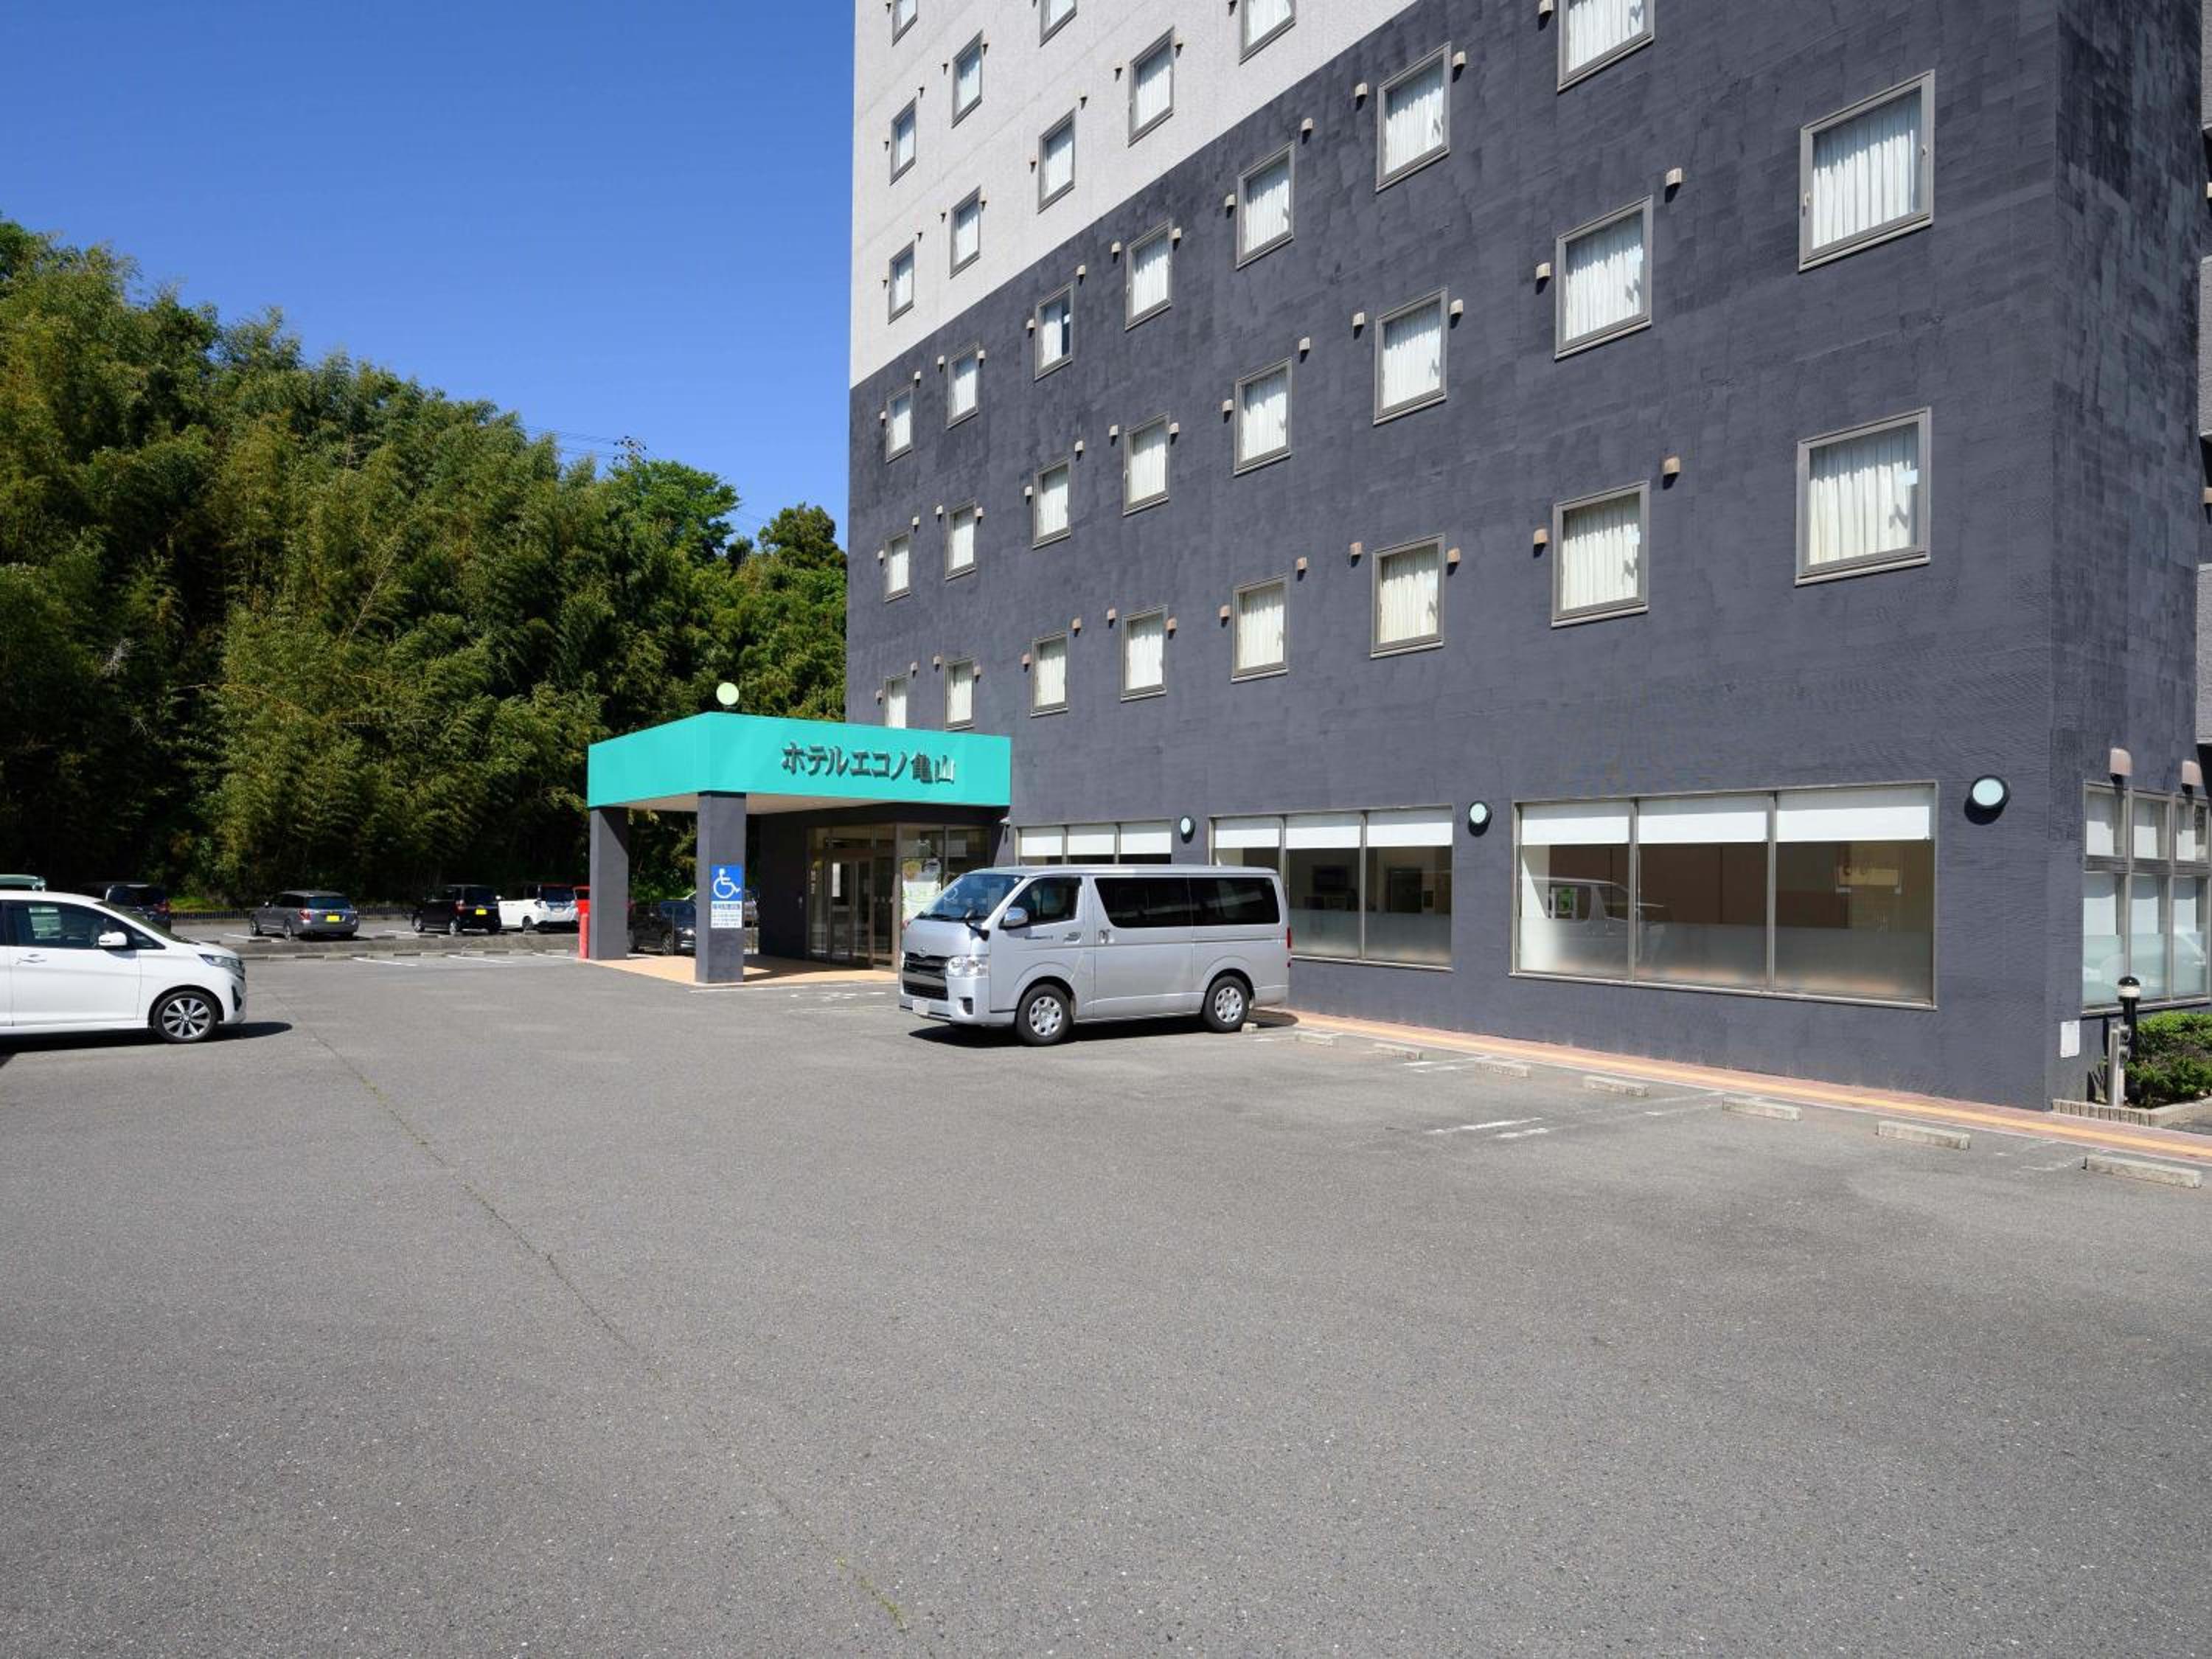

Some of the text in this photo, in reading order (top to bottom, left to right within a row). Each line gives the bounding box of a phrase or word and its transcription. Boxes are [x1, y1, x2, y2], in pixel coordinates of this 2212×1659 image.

[782, 742, 956, 784] ホテルエコノ亀山
